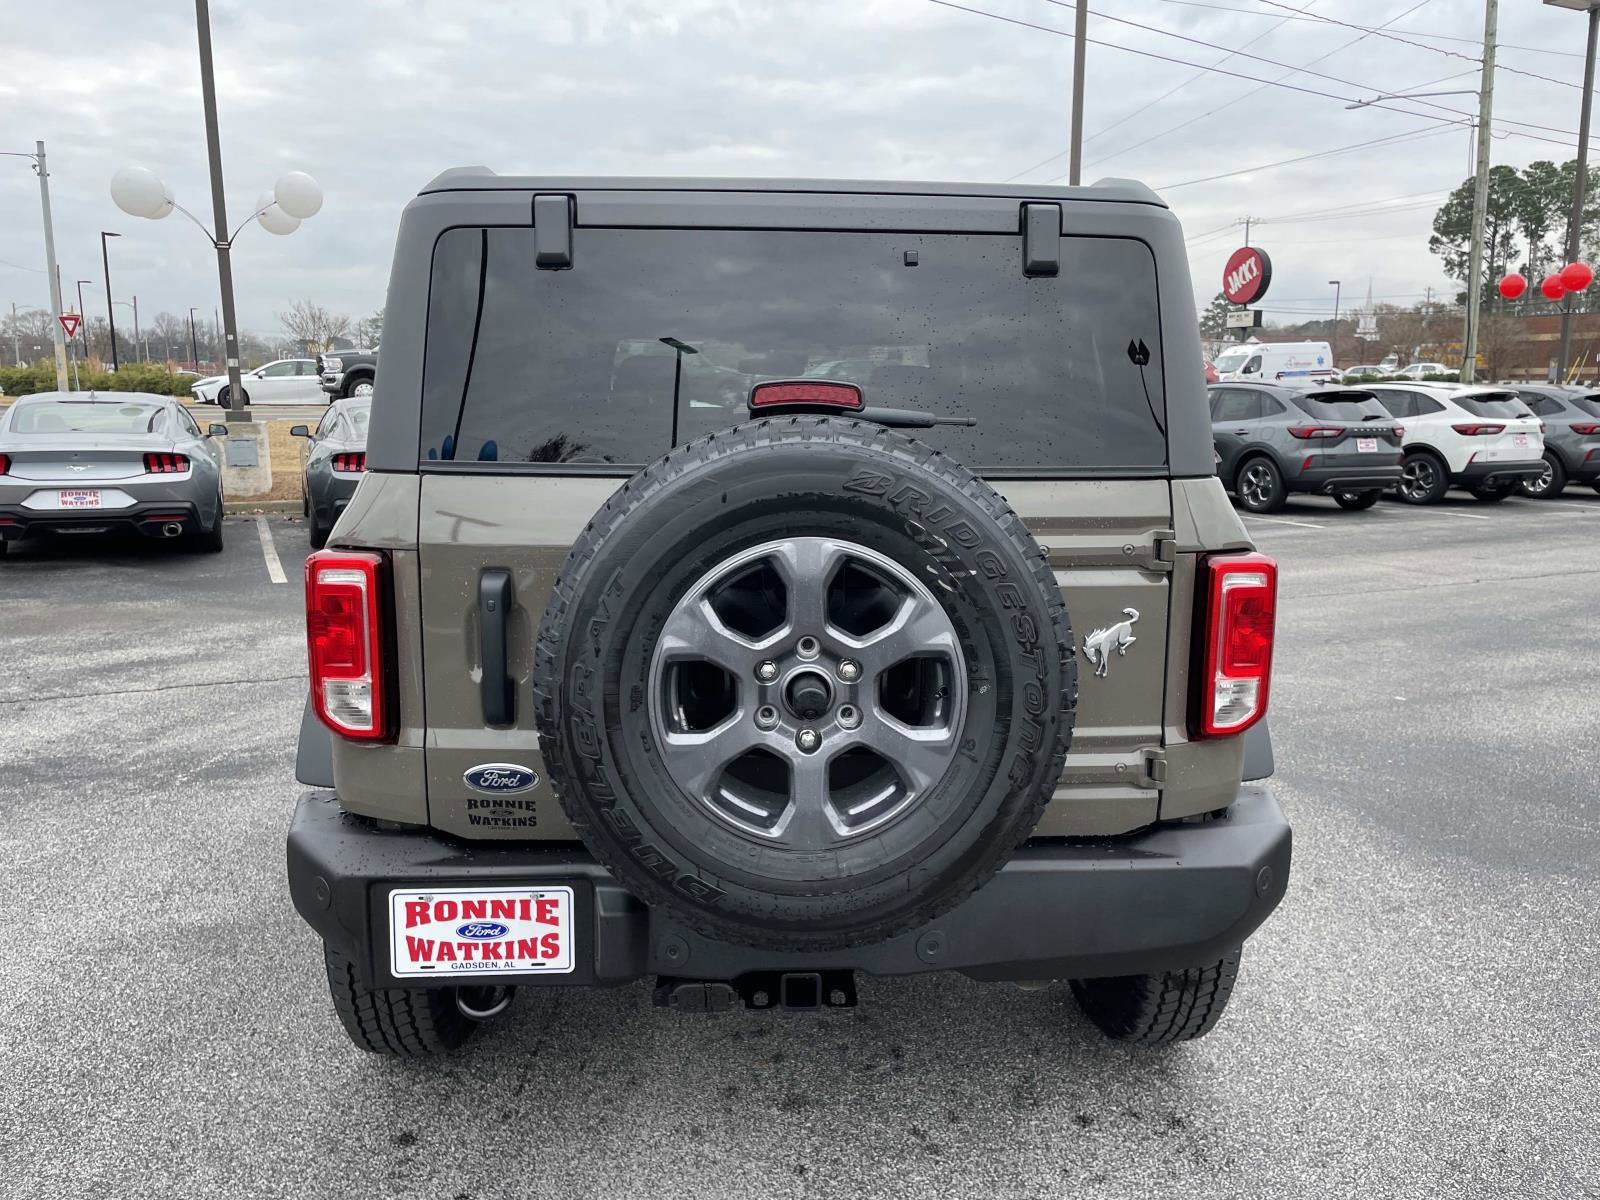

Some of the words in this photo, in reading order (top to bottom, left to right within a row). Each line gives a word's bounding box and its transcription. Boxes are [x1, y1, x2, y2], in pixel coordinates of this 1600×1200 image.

[843, 470, 1049, 789] BRIDGESTONE
[480, 769, 520, 788] Ford
[569, 661, 728, 905] DUELER
[467, 799, 536, 812] RONNIE
[468, 814, 537, 827] WATKINS
[404, 898, 560, 929] RONNIE
[465, 922, 501, 938] Ford
[405, 932, 560, 962] WATKINS
[451, 962, 501, 970] GADSDEN,
[503, 961, 516, 969] AL
